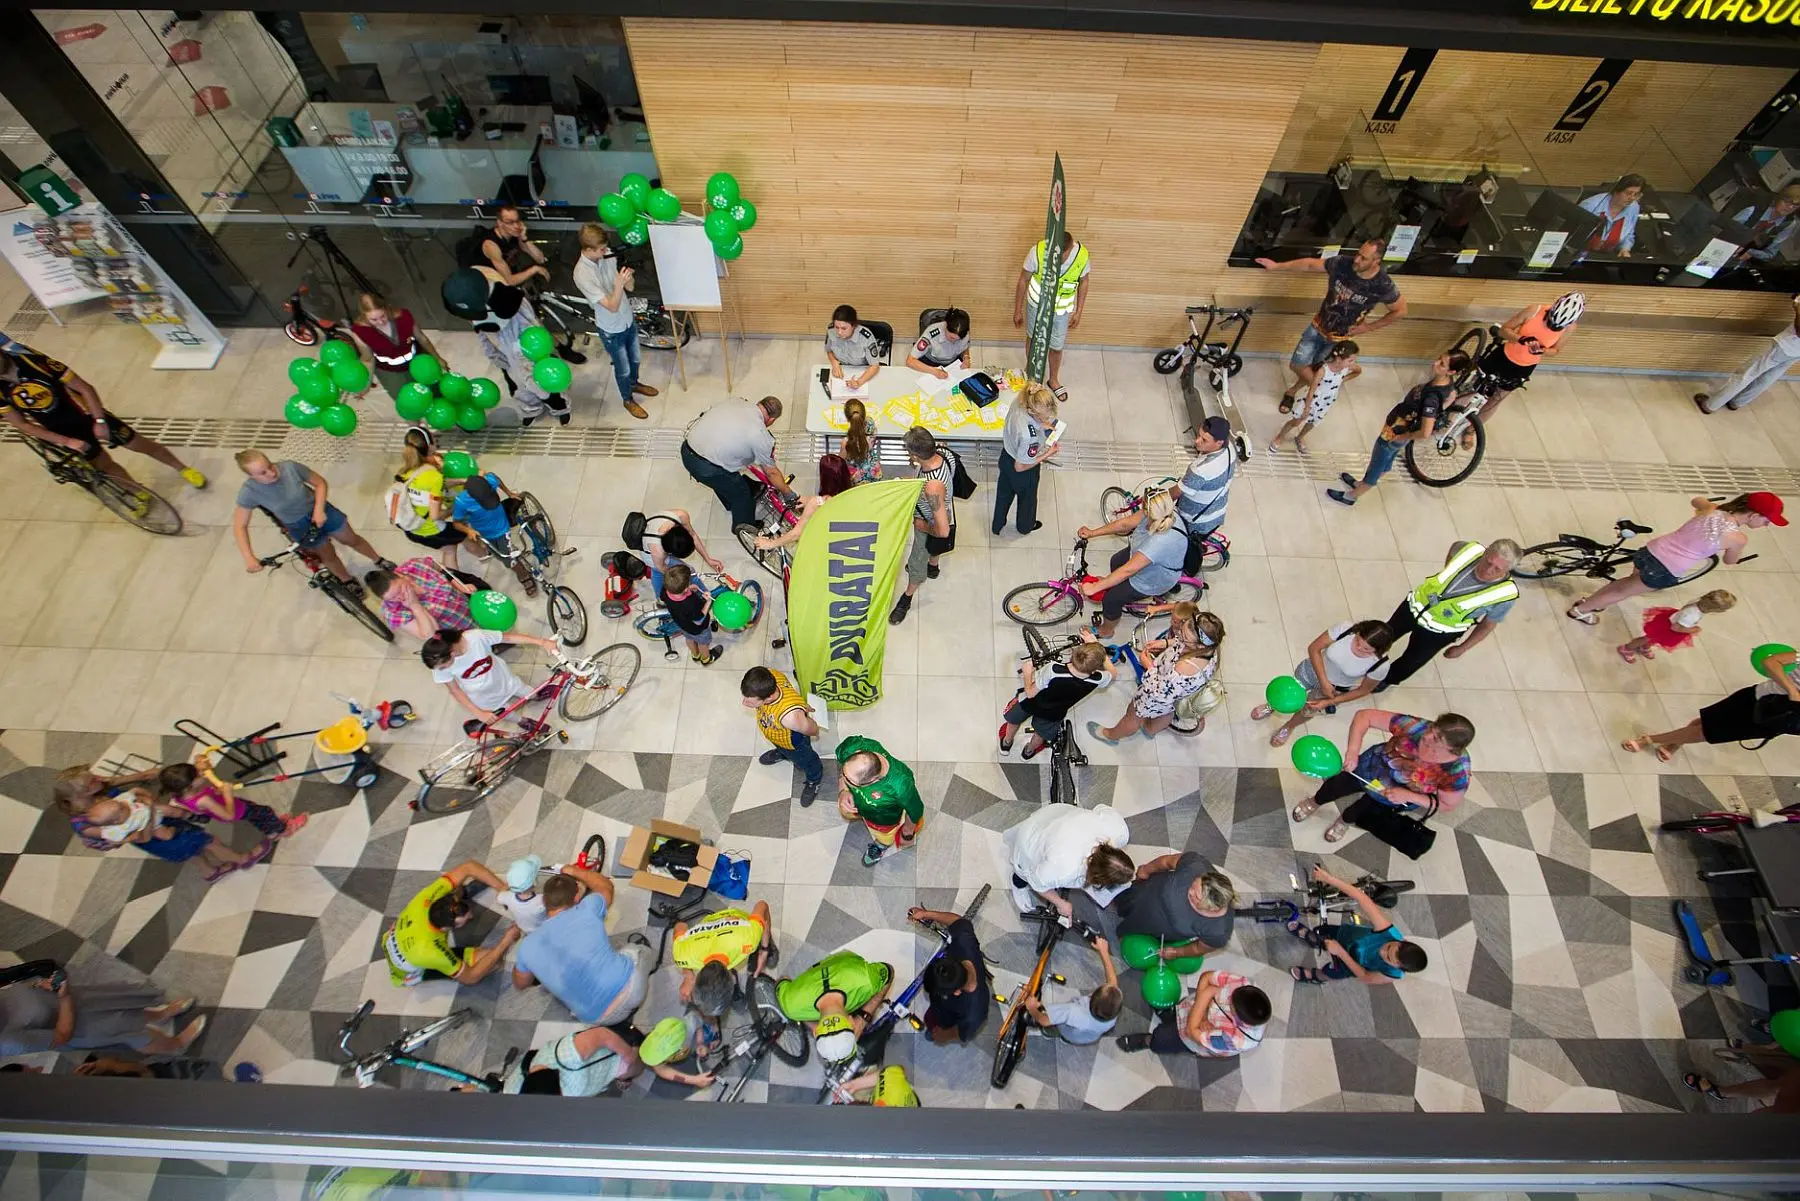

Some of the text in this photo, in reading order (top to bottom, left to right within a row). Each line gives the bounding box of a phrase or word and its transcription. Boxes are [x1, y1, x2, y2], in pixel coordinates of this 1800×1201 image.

[1388, 69, 1416, 114] 1
[1561, 79, 1610, 125] 2
[1364, 122, 1396, 135] KASA
[1543, 131, 1577, 144] KASA
[828, 521, 880, 665] DVIRATAI
[689, 920, 740, 936] DVIRATAI
